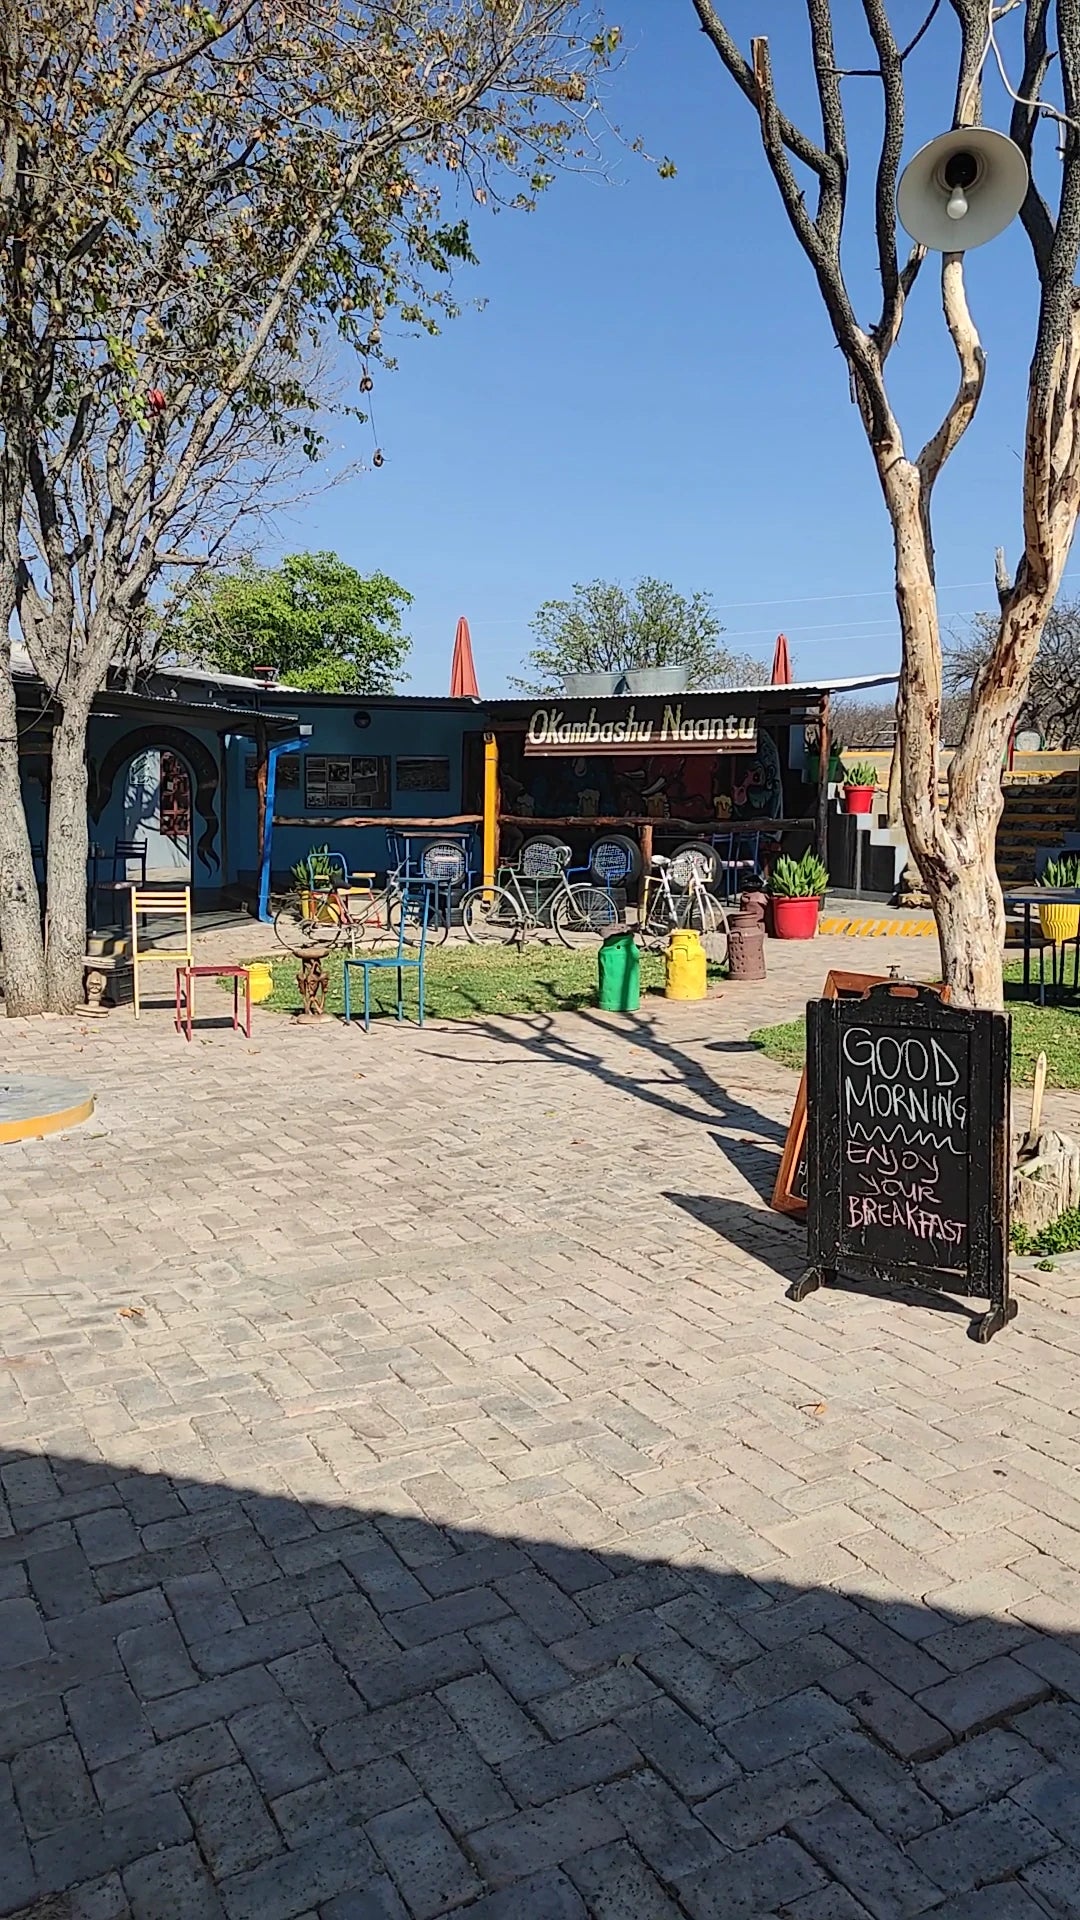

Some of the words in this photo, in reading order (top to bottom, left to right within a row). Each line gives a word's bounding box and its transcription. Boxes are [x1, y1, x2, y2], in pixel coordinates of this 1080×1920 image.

[659, 704, 756, 742] Naantu
[842, 1027, 960, 1086] GOOD
[845, 1074, 967, 1129] MORNING
[846, 1139, 939, 1183] ENJOY
[847, 1195, 967, 1245] BREAKFAST
